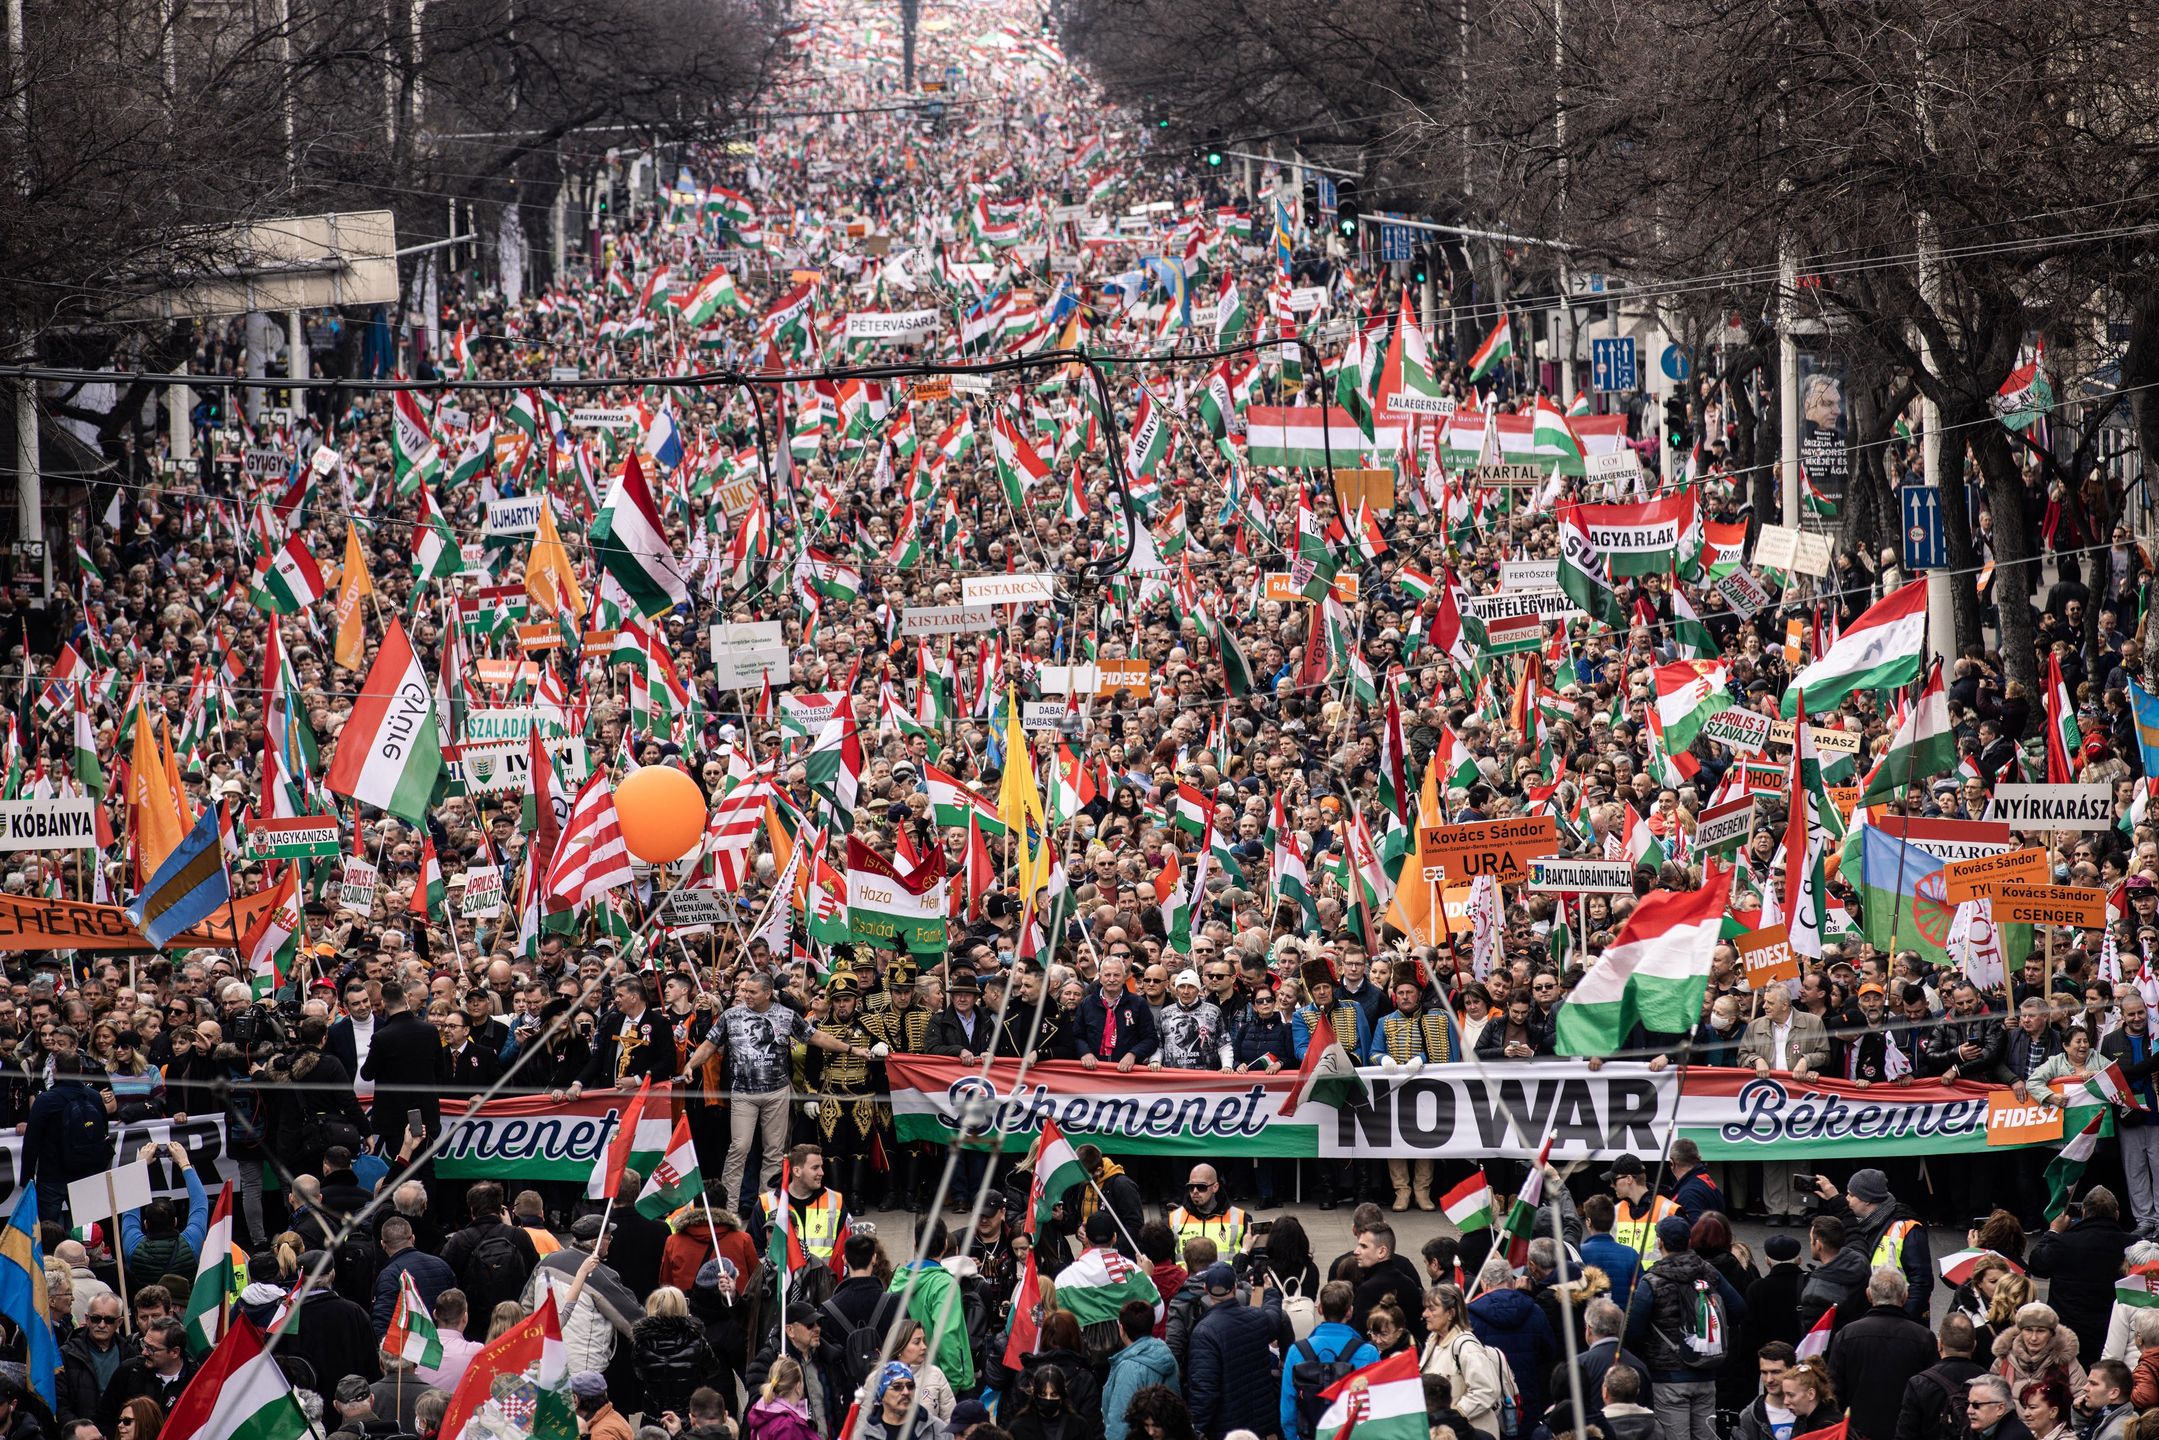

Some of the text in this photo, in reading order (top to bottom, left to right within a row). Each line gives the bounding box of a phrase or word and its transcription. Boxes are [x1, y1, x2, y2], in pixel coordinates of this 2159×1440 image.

[851, 313, 937, 333] PÉTERVÁSÁRA
[1388, 396, 1454, 412] ZALAEGERSZEG
[1483, 466, 1538, 479] KARTAL
[1588, 470, 1637, 482] ZALAEGERSZEG
[1589, 527, 1674, 547] AGYARLAK
[1510, 570, 1559, 579] FERTŐSZÉP
[967, 580, 1047, 598] KISTARCSA
[907, 612, 987, 629] KISTARCSA
[1491, 629, 1540, 643] BERZENCE
[1100, 671, 1148, 686] FIDESZ
[790, 705, 836, 721] NEM LESZÜN
[799, 714, 833, 724] GYARMA
[1704, 721, 1764, 747] SZAVAZZ!
[1995, 793, 2111, 821] NYÍRKARÁSZ
[12, 806, 93, 838] KŐBÁNYA
[1697, 813, 1751, 846] JÁSZBERÉNY
[269, 830, 335, 845] NAGYKANIZSA
[1430, 823, 1546, 845] Kovács Sándor
[863, 855, 895, 879] Isten
[1463, 851, 1518, 876] URA
[1953, 861, 1994, 877] Kovács
[1996, 854, 2038, 868] Sándor
[344, 864, 367, 887] ÁPRILIS
[465, 874, 494, 896] ÁPRILIS
[1545, 865, 1633, 888] BAKTALÓRÁNTHÁZA
[341, 884, 373, 906] SZAVAZZ!
[463, 889, 500, 914] SZAVAZZ!
[673, 891, 699, 903] ELŐRE
[859, 884, 892, 904] Haza
[2002, 886, 2096, 902] Kovács Sándor
[676, 902, 717, 914] MENJÜNK,
[679, 912, 721, 924] NE HÁTRA!
[2013, 908, 2085, 924] CSENGER
[1744, 942, 1792, 972] FIDESZ
[1337, 1078, 1661, 1151] NO WAR
[1991, 1103, 2059, 1129] FIDESZ
